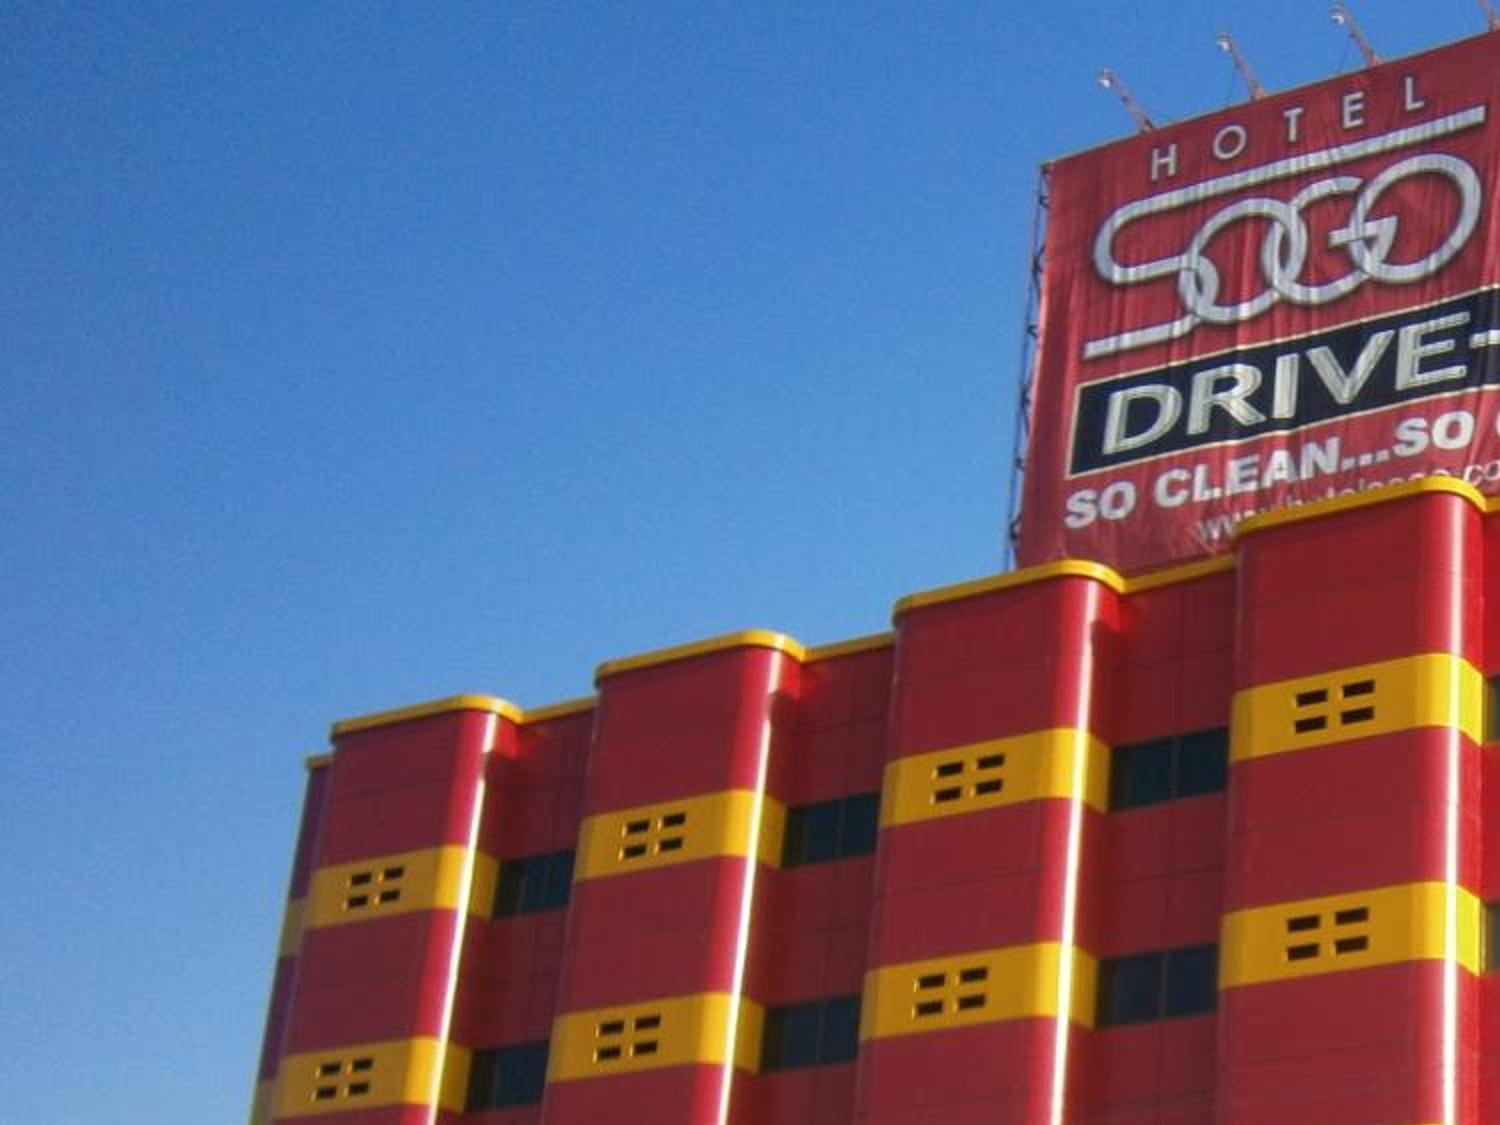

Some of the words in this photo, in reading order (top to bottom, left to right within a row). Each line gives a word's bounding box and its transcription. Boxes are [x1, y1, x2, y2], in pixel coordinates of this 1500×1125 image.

[1151, 76, 1426, 182] HOTEL
[1084, 104, 1487, 359] SOGO
[1064, 480, 1136, 530] SO
